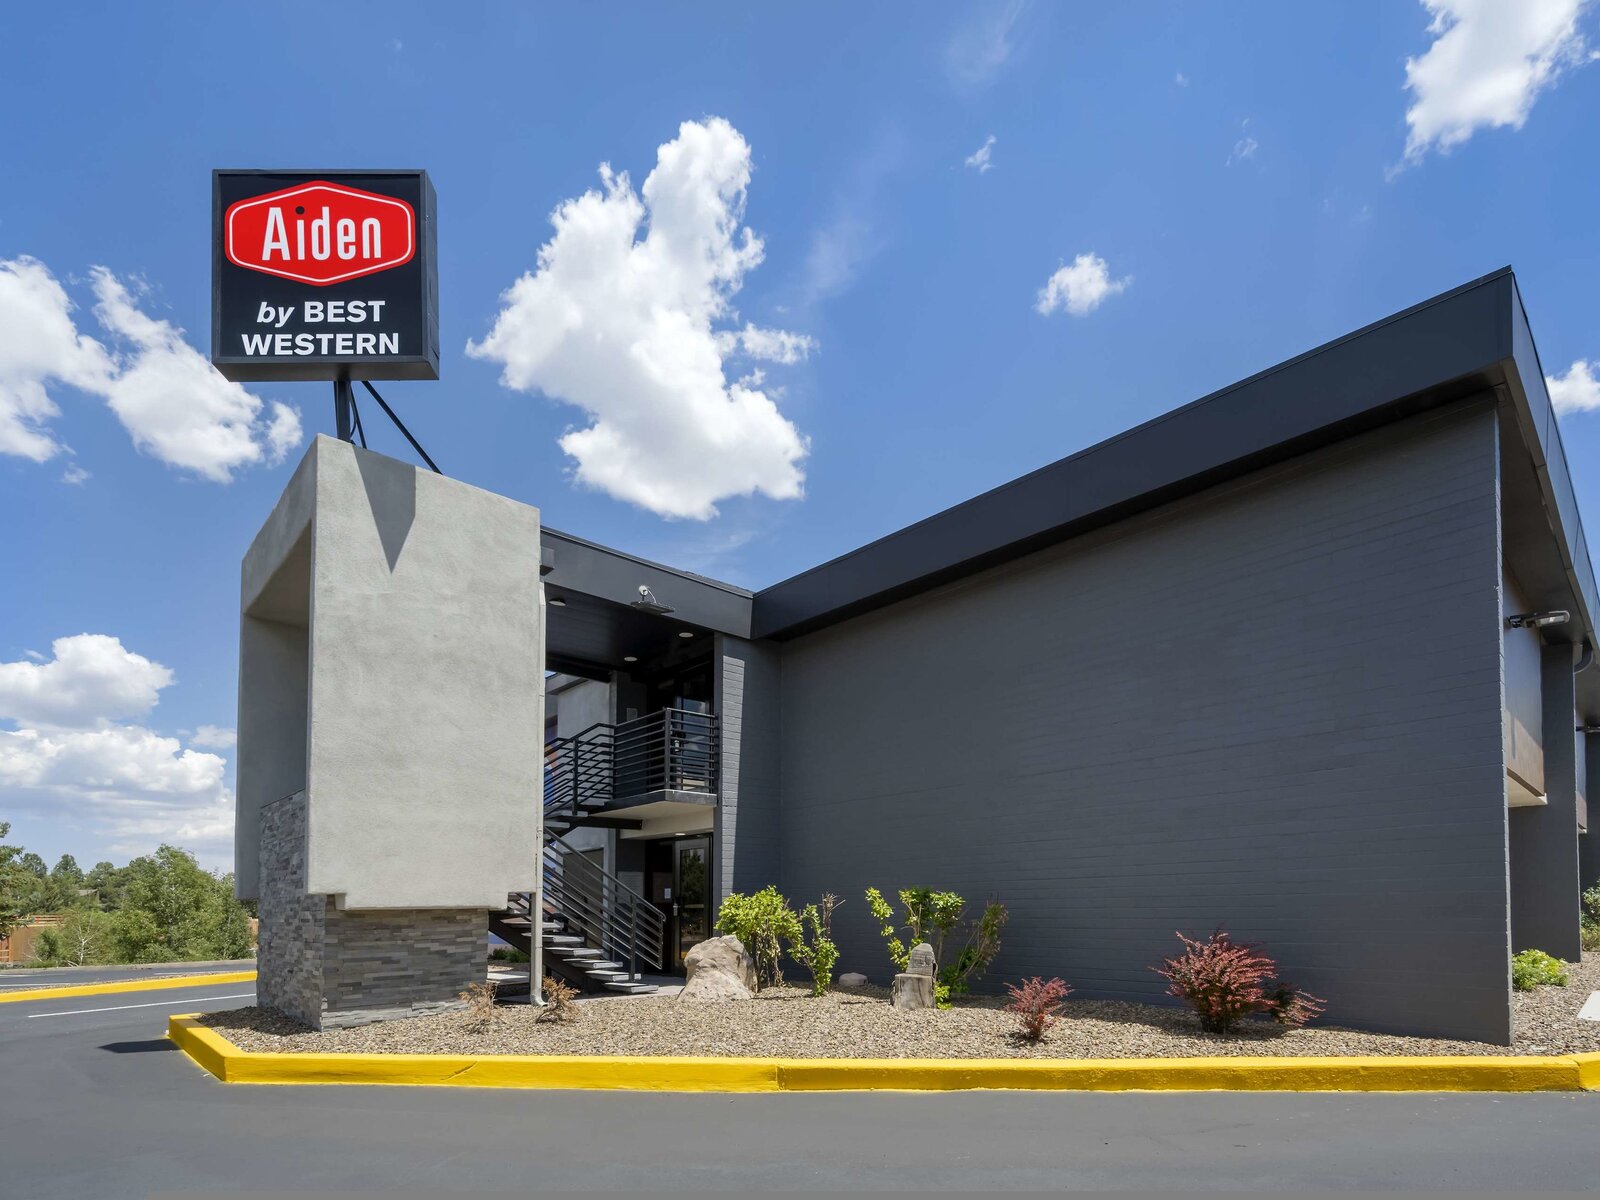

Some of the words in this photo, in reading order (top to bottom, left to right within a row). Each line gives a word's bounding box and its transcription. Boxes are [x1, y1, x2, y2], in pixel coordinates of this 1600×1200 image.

[262, 206, 382, 261] Aiden
[256, 302, 295, 328] by
[304, 300, 386, 323] BEST
[241, 332, 399, 356] WESTERN
